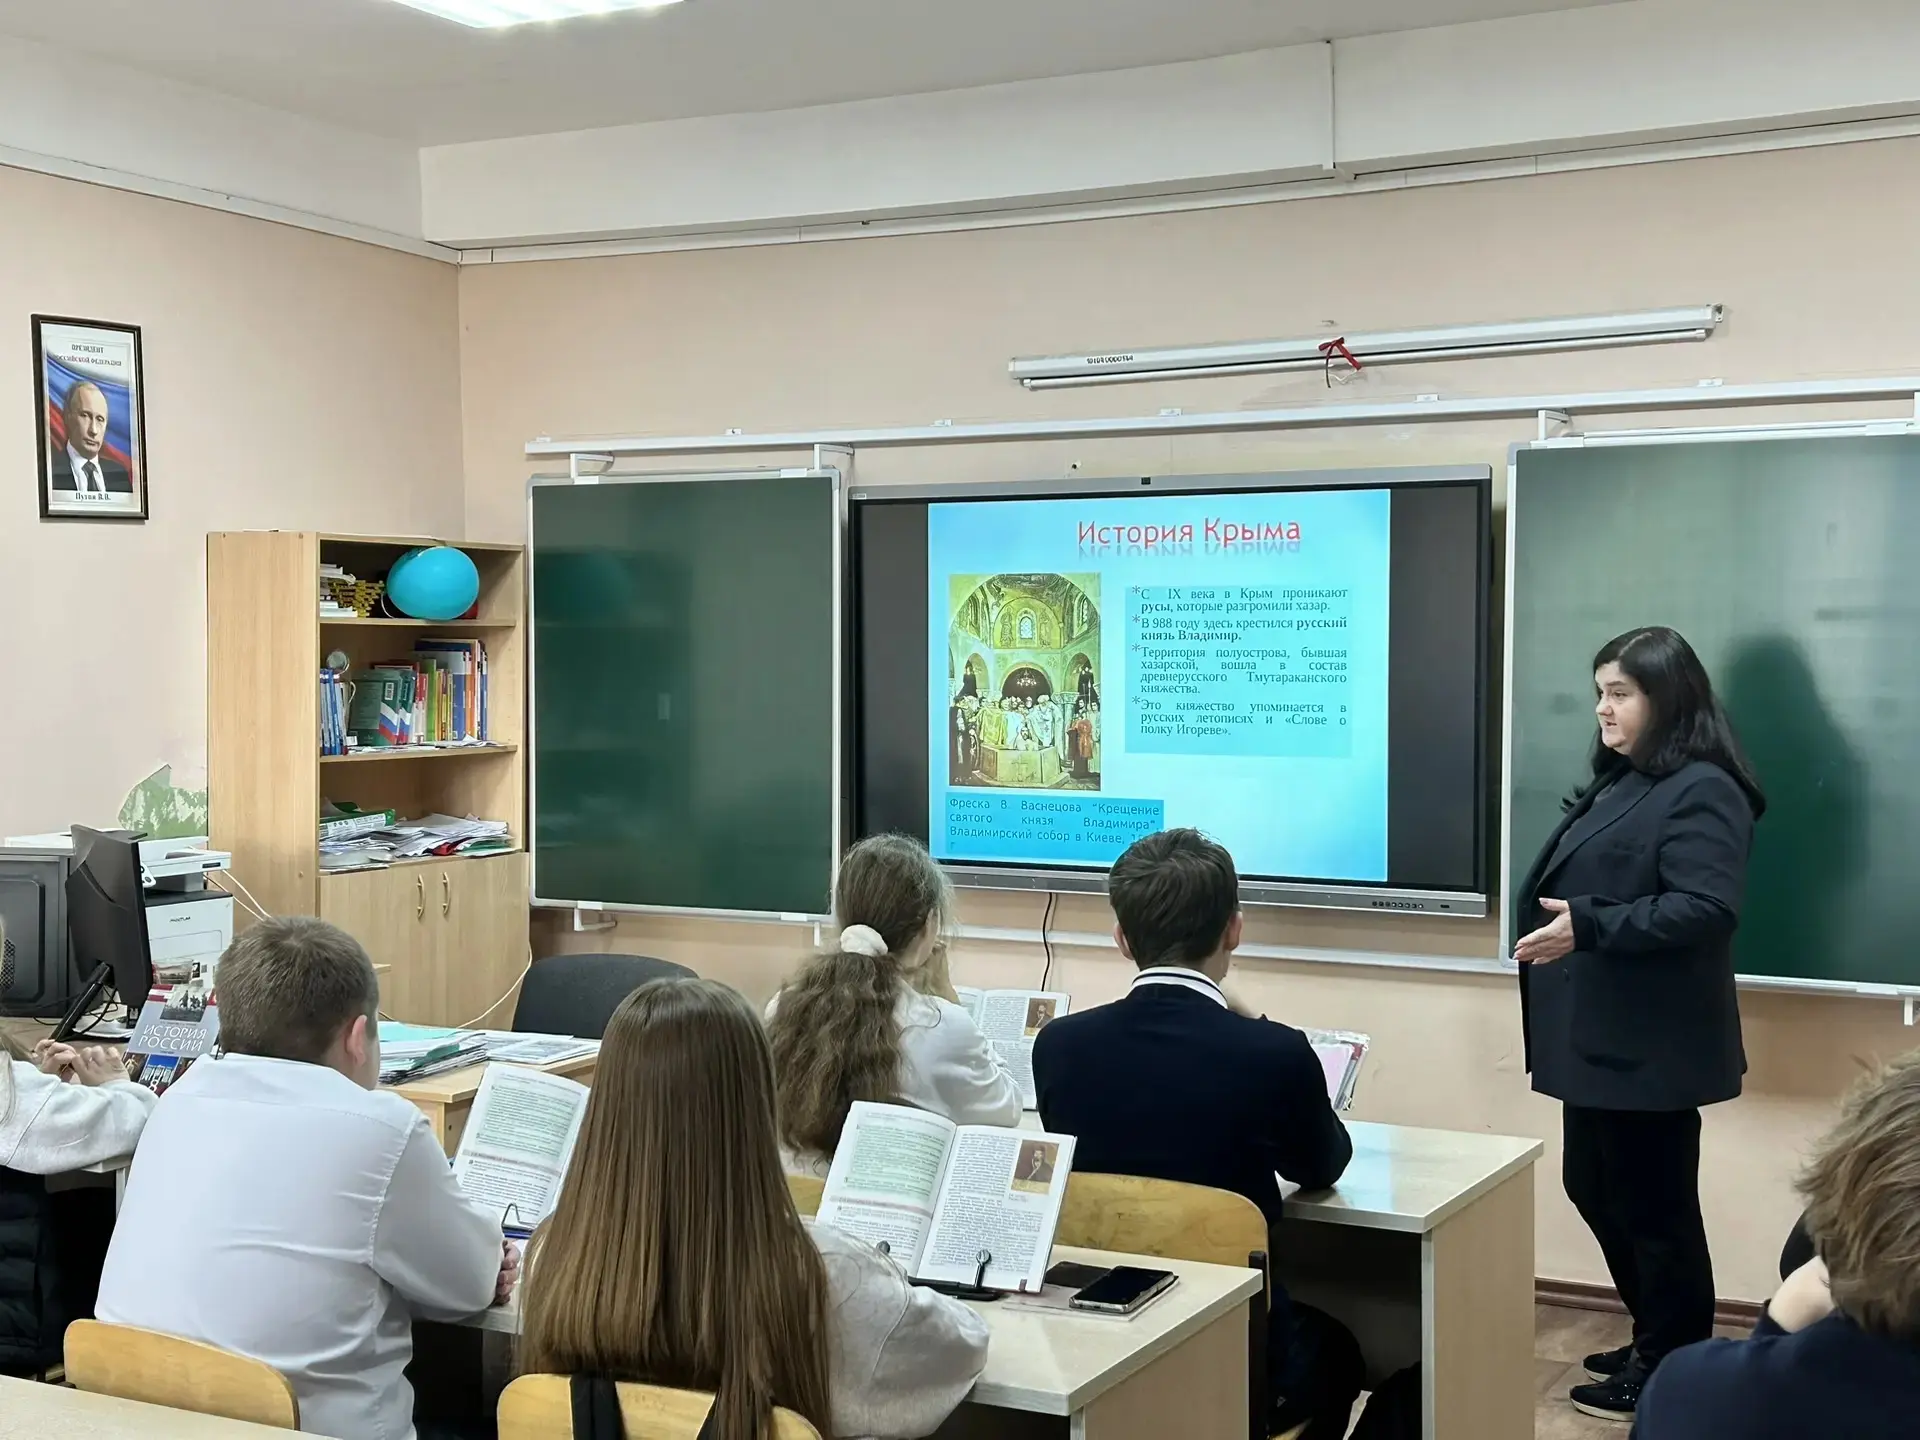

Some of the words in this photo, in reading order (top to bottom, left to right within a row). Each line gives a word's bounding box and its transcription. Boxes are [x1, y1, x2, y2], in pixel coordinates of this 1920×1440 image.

[1078, 520, 1193, 549] История
[1204, 517, 1301, 547] Крыма
[1141, 589, 1150, 600] С
[1168, 588, 1182, 599] IX
[1191, 590, 1215, 599] века
[1224, 591, 1231, 599] в
[1240, 587, 1273, 601] Крым
[1282, 588, 1348, 601] проникают
[1141, 602, 1174, 614] русы,
[1176, 602, 1223, 614] которые
[1226, 600, 1292, 614] разгромили
[1295, 602, 1331, 613] хазар.
[1141, 618, 1150, 628] В
[1152, 617, 1173, 628] 988
[1175, 620, 1200, 631] году
[1203, 620, 1233, 631] здесь
[1236, 617, 1293, 630] крестился
[1296, 616, 1347, 630] русский
[1141, 630, 1175, 640] князь
[1178, 629, 1242, 643] Владимир.
[1141, 647, 1206, 658] Территория
[1216, 647, 1290, 660] полуострова,
[1301, 646, 1347, 658] бывшая
[1141, 658, 1199, 671] хазарской,
[1221, 661, 1257, 670] вошла
[1280, 661, 1286, 670] в
[1309, 662, 1347, 671] состав
[1140, 671, 1228, 684] древнерусского
[1247, 671, 1347, 685] Тмутараканского
[1141, 684, 1201, 694] княжества.
[1141, 699, 1161, 710] Это
[1176, 701, 1235, 711] княжество
[1250, 702, 1324, 714] упоминается
[1340, 704, 1347, 712] в
[1141, 713, 1185, 725] русских
[1196, 714, 1254, 725] летописях
[1266, 716, 1273, 724] и
[1285, 713, 1328, 725] «Слове
[1339, 717, 1346, 726] о
[1141, 723, 1173, 736] полку
[1176, 723, 1232, 737] Игореве».
[949, 798, 990, 809] Фреска
[1021, 801, 1081, 813] Васнецова
[949, 814, 993, 824] святого
[1021, 816, 1054, 825] князя
[950, 826, 1032, 839] Владимирский
[1037, 831, 1070, 842] собор
[1075, 833, 1081, 841] в
[1086, 831, 1125, 844] Киеве,
[143, 1024, 208, 1040] ИСТОРИЯ
[138, 1035, 204, 1052] РОССИИ
